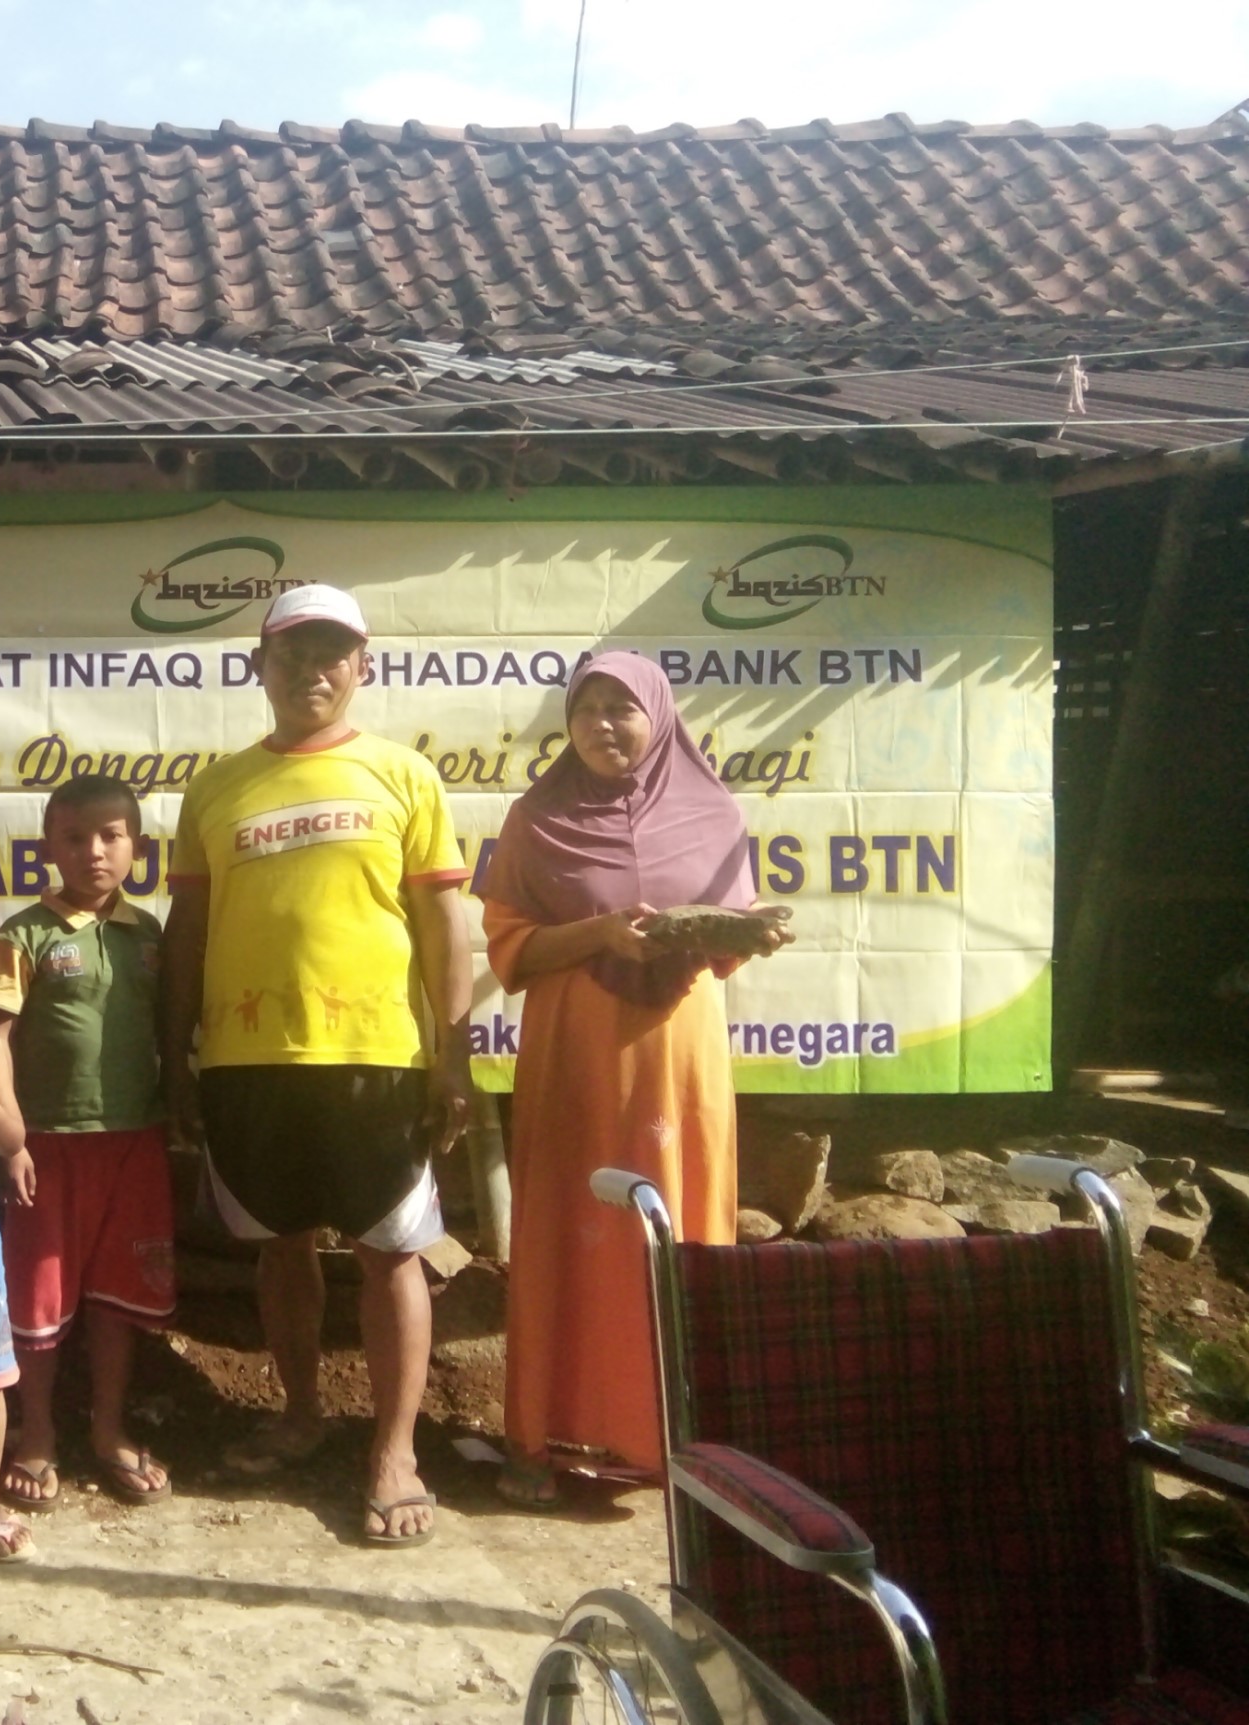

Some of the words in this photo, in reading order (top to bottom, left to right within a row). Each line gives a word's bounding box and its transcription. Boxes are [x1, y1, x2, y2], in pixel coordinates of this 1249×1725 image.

[49, 651, 204, 690] INFAQ
[660, 650, 802, 685] BANK
[819, 649, 923, 684] BTN
[234, 811, 374, 852] ENERGEN
[829, 835, 956, 893] BTN
[728, 1022, 895, 1067] rnegara
